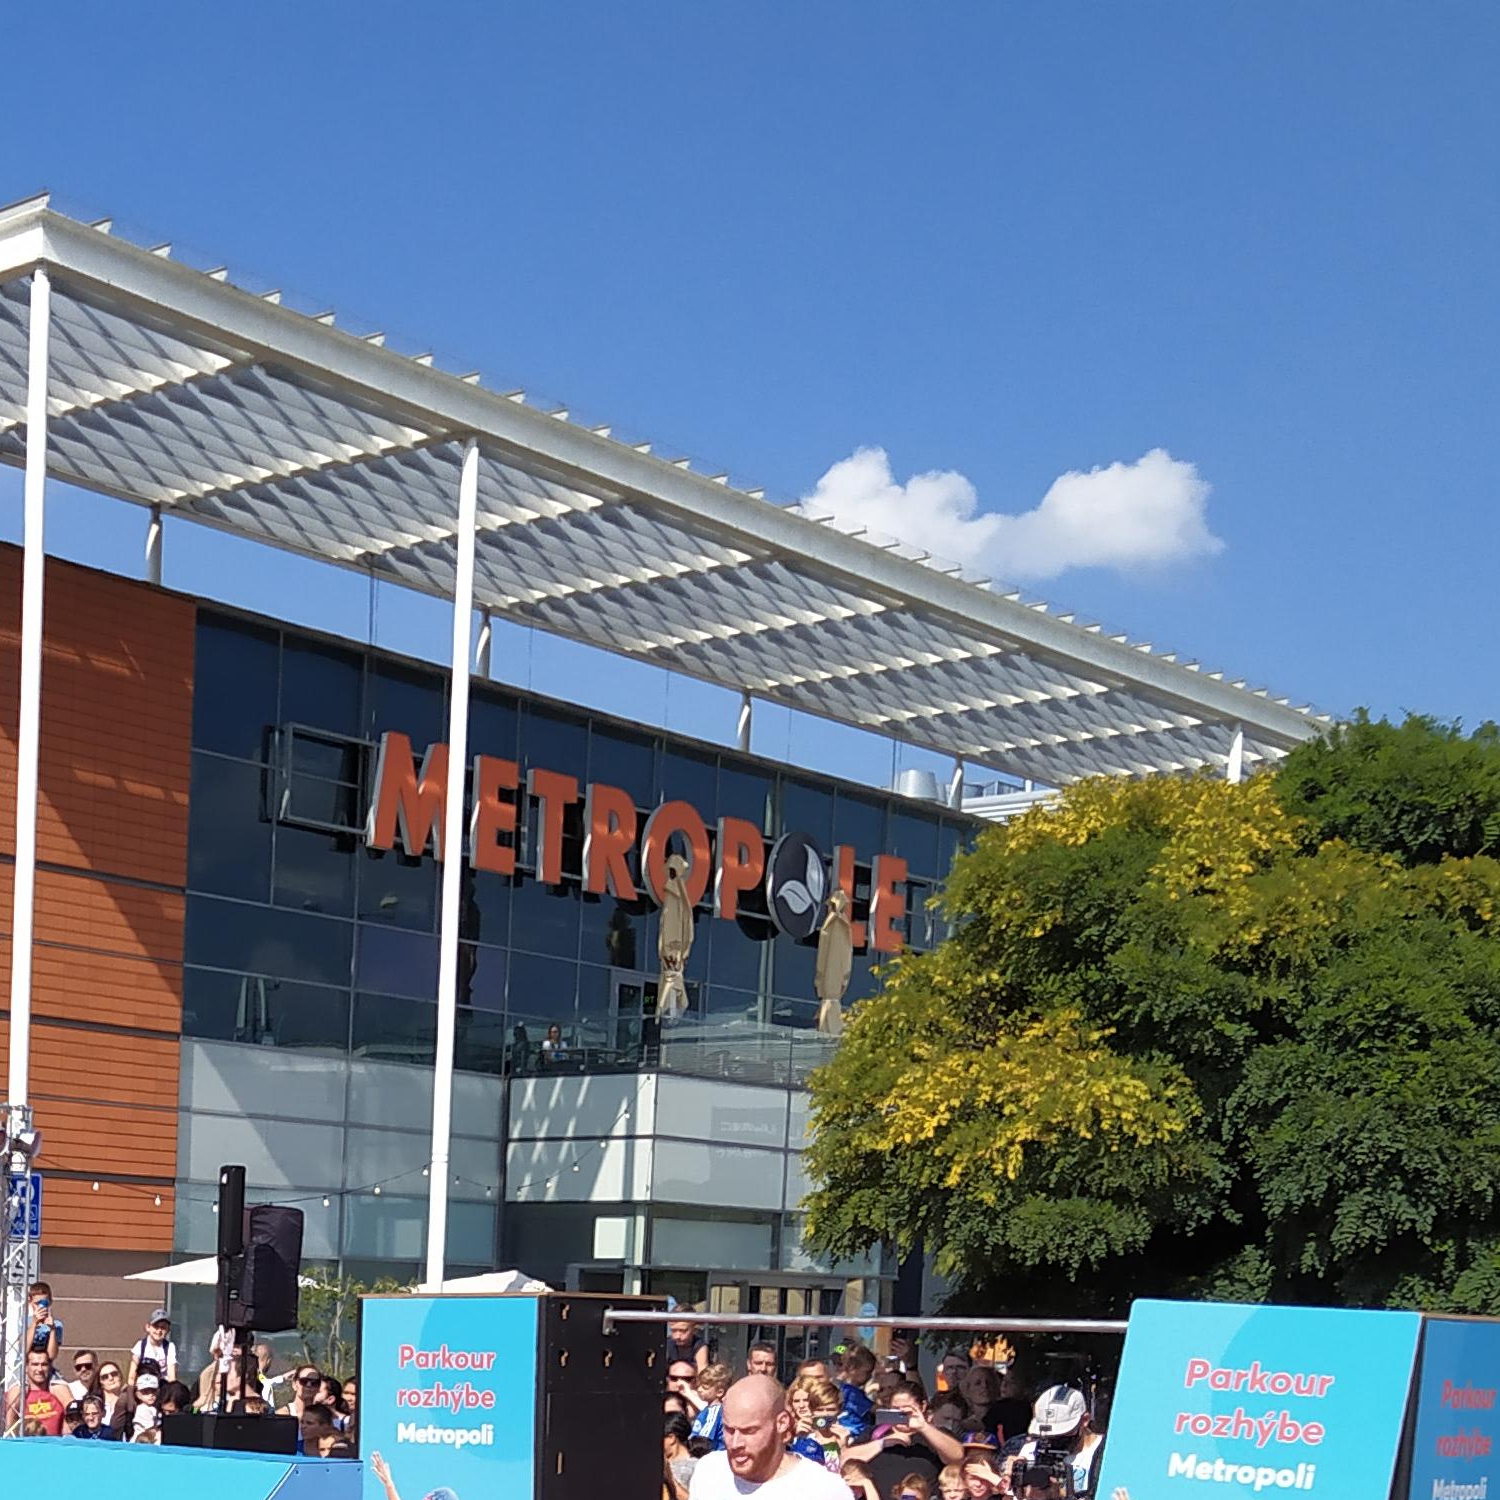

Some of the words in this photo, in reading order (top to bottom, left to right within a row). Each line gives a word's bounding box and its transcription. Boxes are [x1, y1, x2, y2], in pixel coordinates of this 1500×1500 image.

[398, 1343, 496, 1371] Parkour
[1184, 1357, 1335, 1398] Parkour
[396, 1381, 495, 1415] rozhýbe
[396, 1422, 494, 1449] Metropoli
[1174, 1406, 1326, 1449] rozhýbe
[1167, 1452, 1317, 1492] Metropoli
